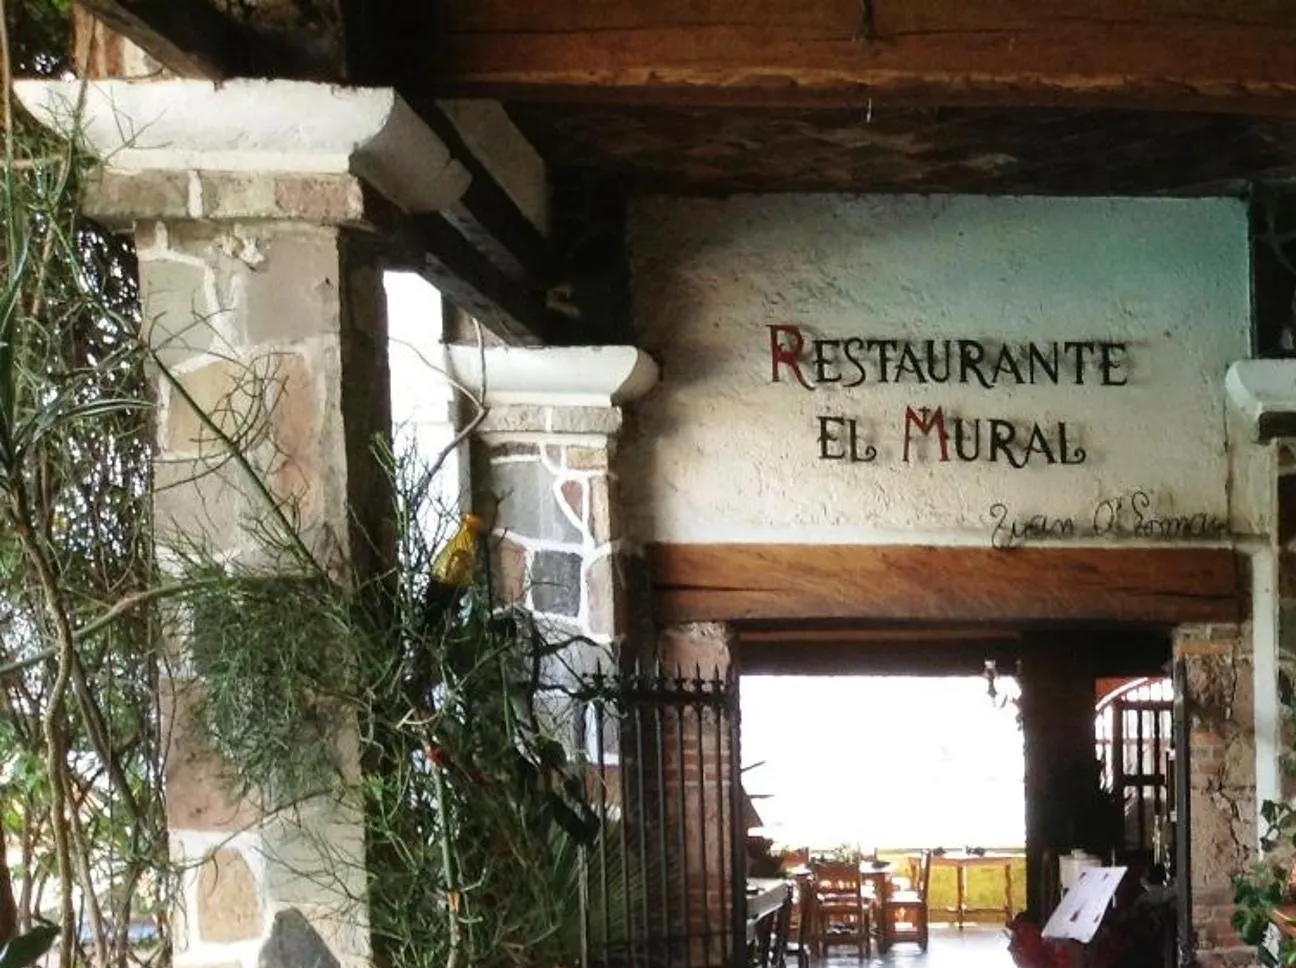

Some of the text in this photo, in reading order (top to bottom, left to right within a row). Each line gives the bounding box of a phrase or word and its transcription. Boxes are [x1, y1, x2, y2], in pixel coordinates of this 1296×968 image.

[766, 324, 1127, 391] RESTAURANTE
[816, 405, 1087, 469] EL MURAL
